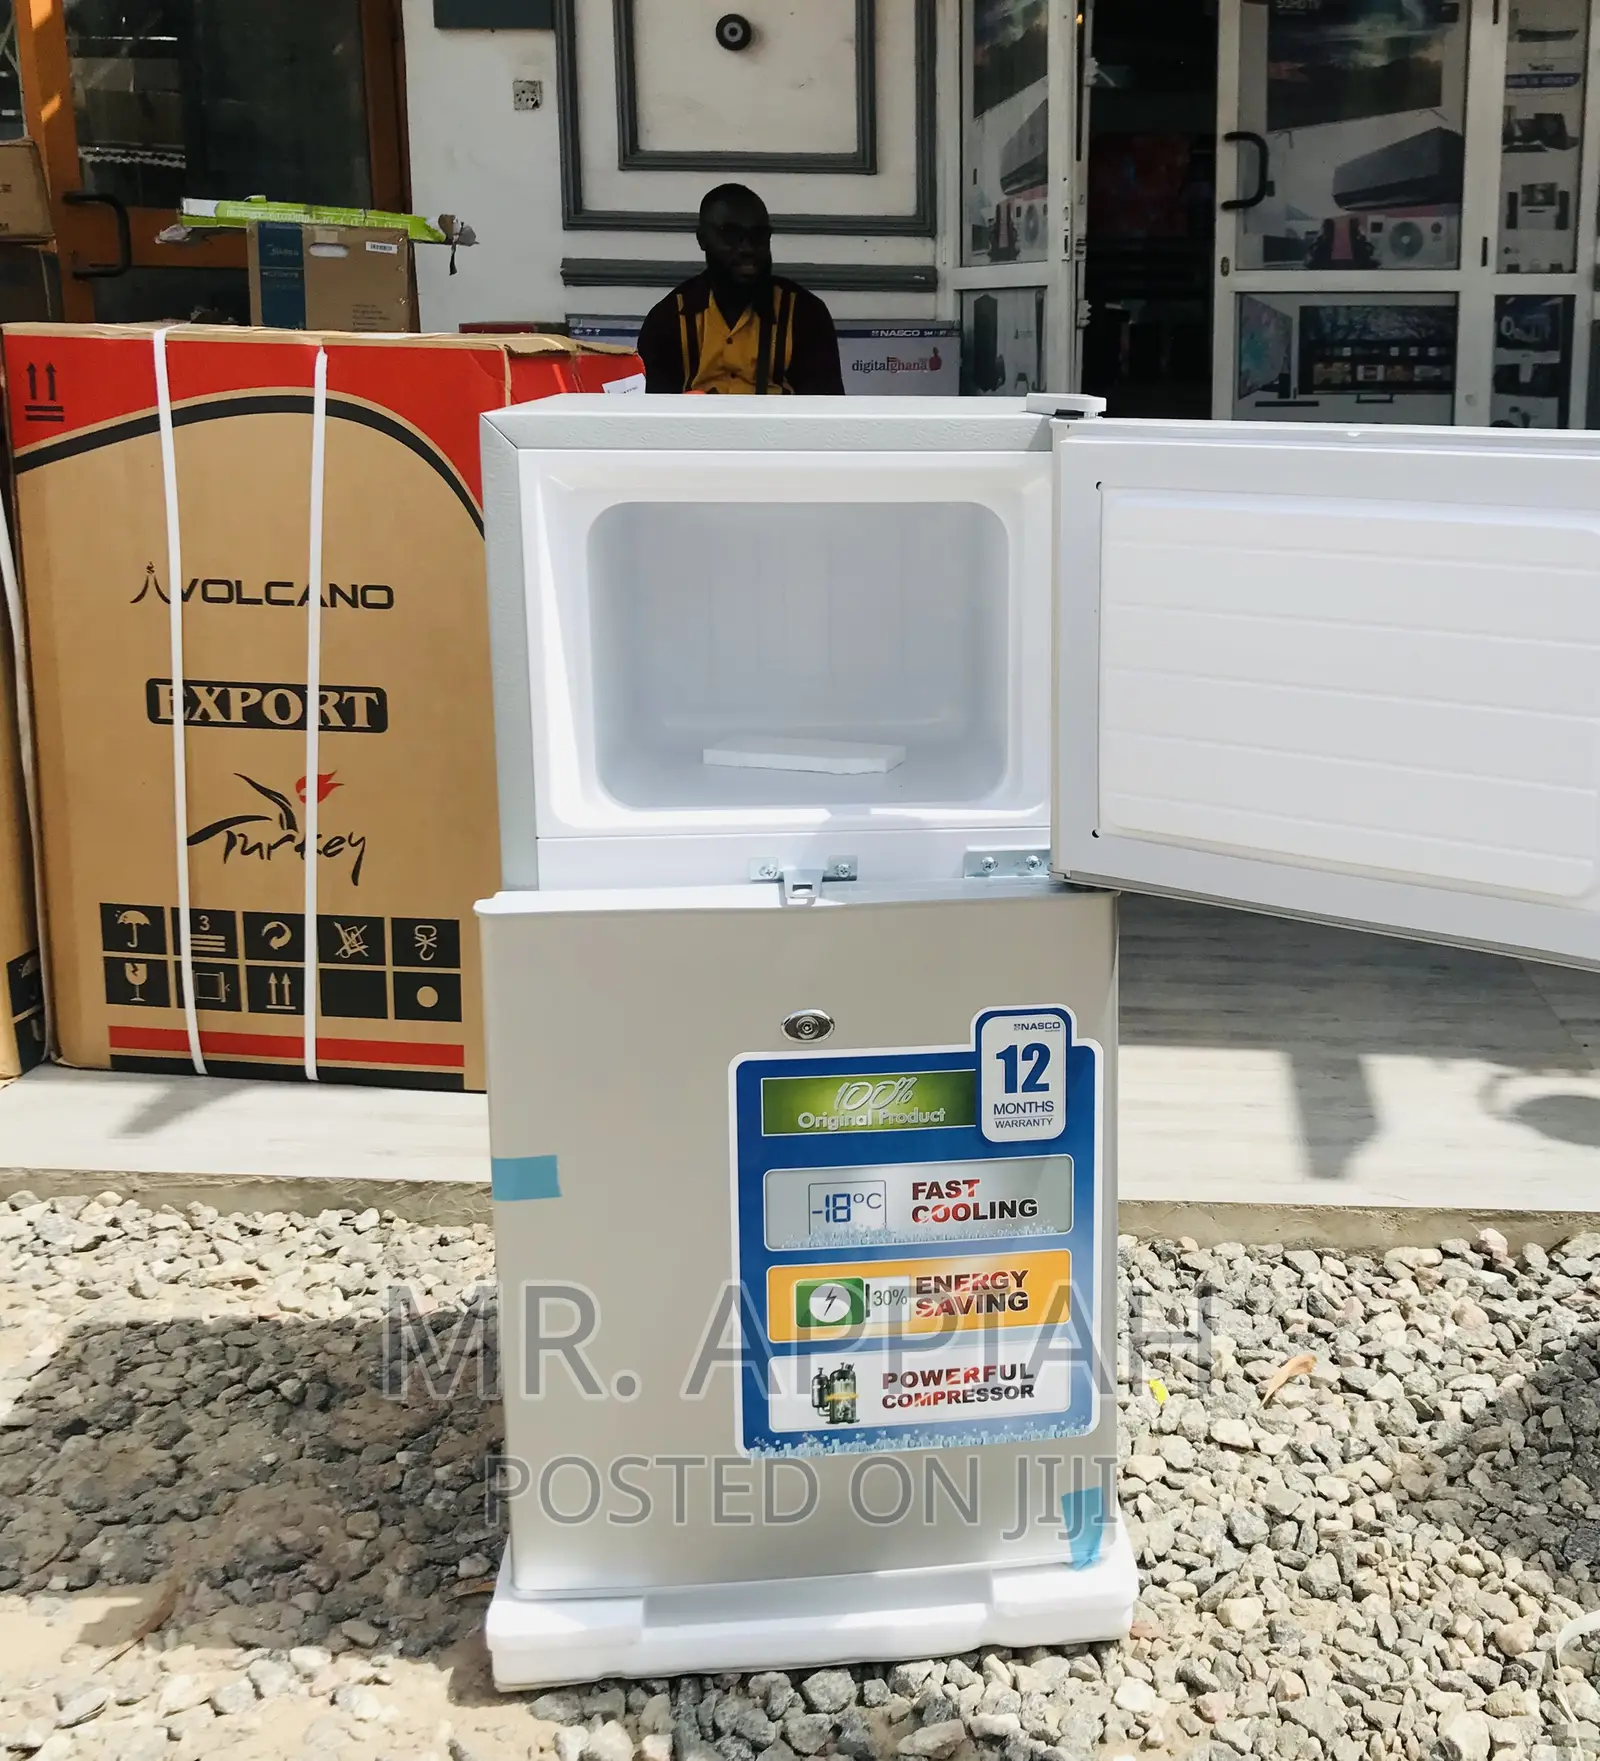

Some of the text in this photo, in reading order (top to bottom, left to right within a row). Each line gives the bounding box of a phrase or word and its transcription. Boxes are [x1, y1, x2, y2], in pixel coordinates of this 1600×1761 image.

[879, 329, 921, 337] NASCO
[180, 578, 394, 609] VOLCANO
[155, 683, 379, 728] EXPORT
[199, 915, 211, 932] 3
[1020, 1021, 1061, 1031] NASCO
[995, 1042, 1051, 1094] 12
[833, 1076, 918, 1112] 100%
[797, 1107, 946, 1131] Original Product
[993, 1101, 1054, 1115] MONTHS
[994, 1117, 1053, 1129] WARRANTY
[911, 1178, 981, 1201] FAST
[911, 1198, 1038, 1224] COOLING
[915, 1269, 1029, 1295] ENERGY
[872, 1288, 908, 1307] 30%
[915, 1291, 1029, 1318] SAVING
[882, 1363, 1034, 1390] POWERFUL
[882, 1384, 1035, 1409] COMPRESSOR
